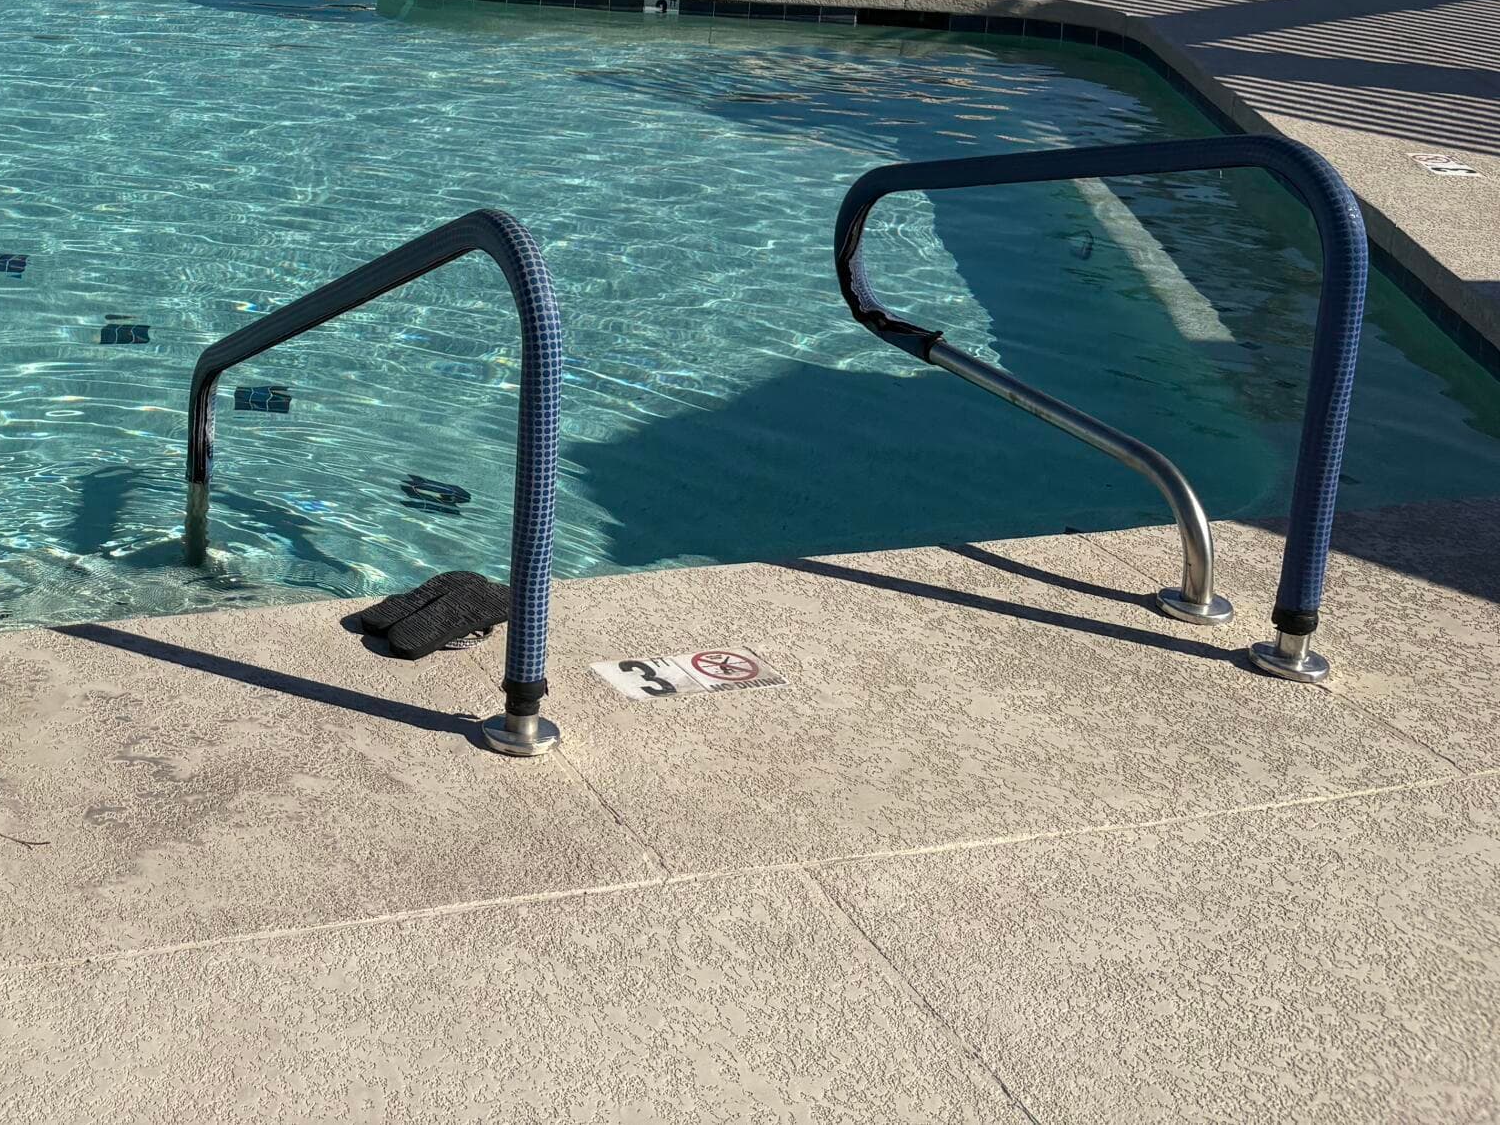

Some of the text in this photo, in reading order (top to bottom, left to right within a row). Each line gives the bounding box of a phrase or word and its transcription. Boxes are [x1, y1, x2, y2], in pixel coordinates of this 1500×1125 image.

[618, 657, 677, 697] 3 FT
[709, 676, 787, 693] NO DIVING
